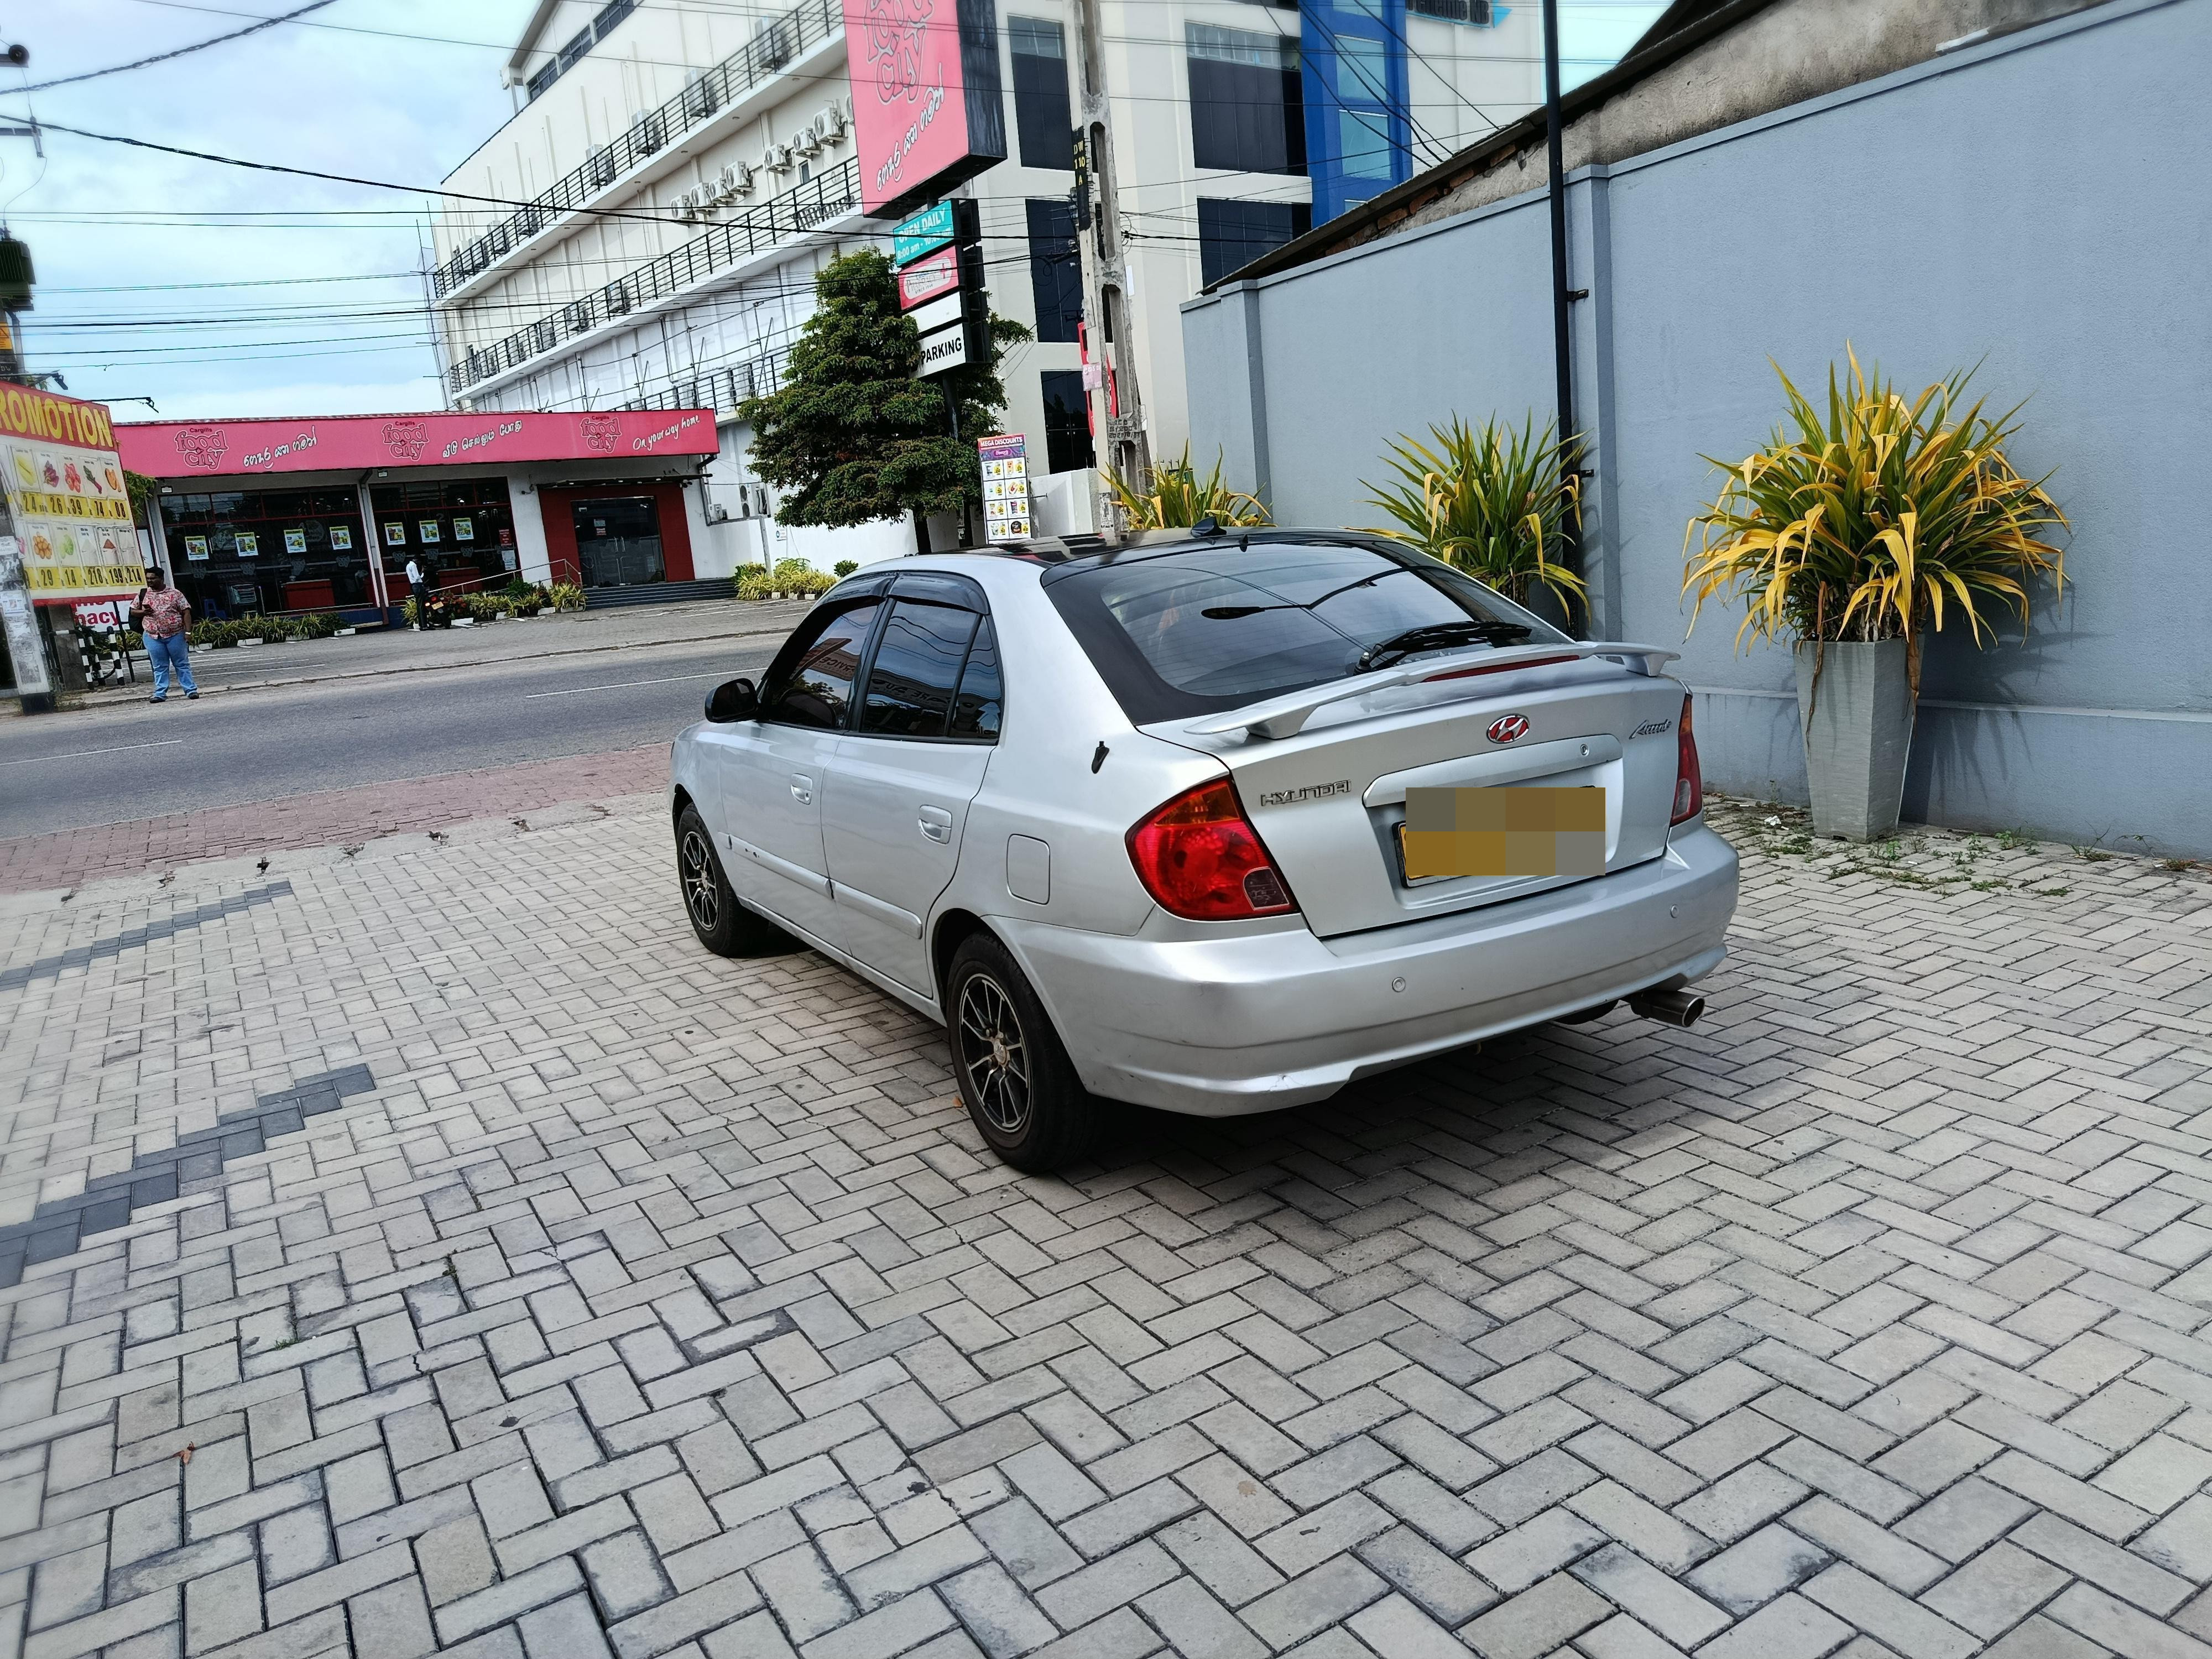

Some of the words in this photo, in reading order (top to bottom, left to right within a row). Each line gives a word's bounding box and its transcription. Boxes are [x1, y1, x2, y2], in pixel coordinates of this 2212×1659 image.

[898, 221, 920, 243] OPEN
[921, 207, 946, 231] DAILY
[910, 243, 920, 253] am
[921, 337, 962, 365] PARKING
[0, 388, 113, 447] ROMOTION
[633, 437, 647, 450] On
[648, 429, 664, 451] your
[665, 424, 679, 440] way
[681, 415, 700, 429] home
[995, 436, 1022, 445] DISCOUNTS
[41, 569, 54, 586] 29
[1261, 779, 1352, 806] HYUNDAI
